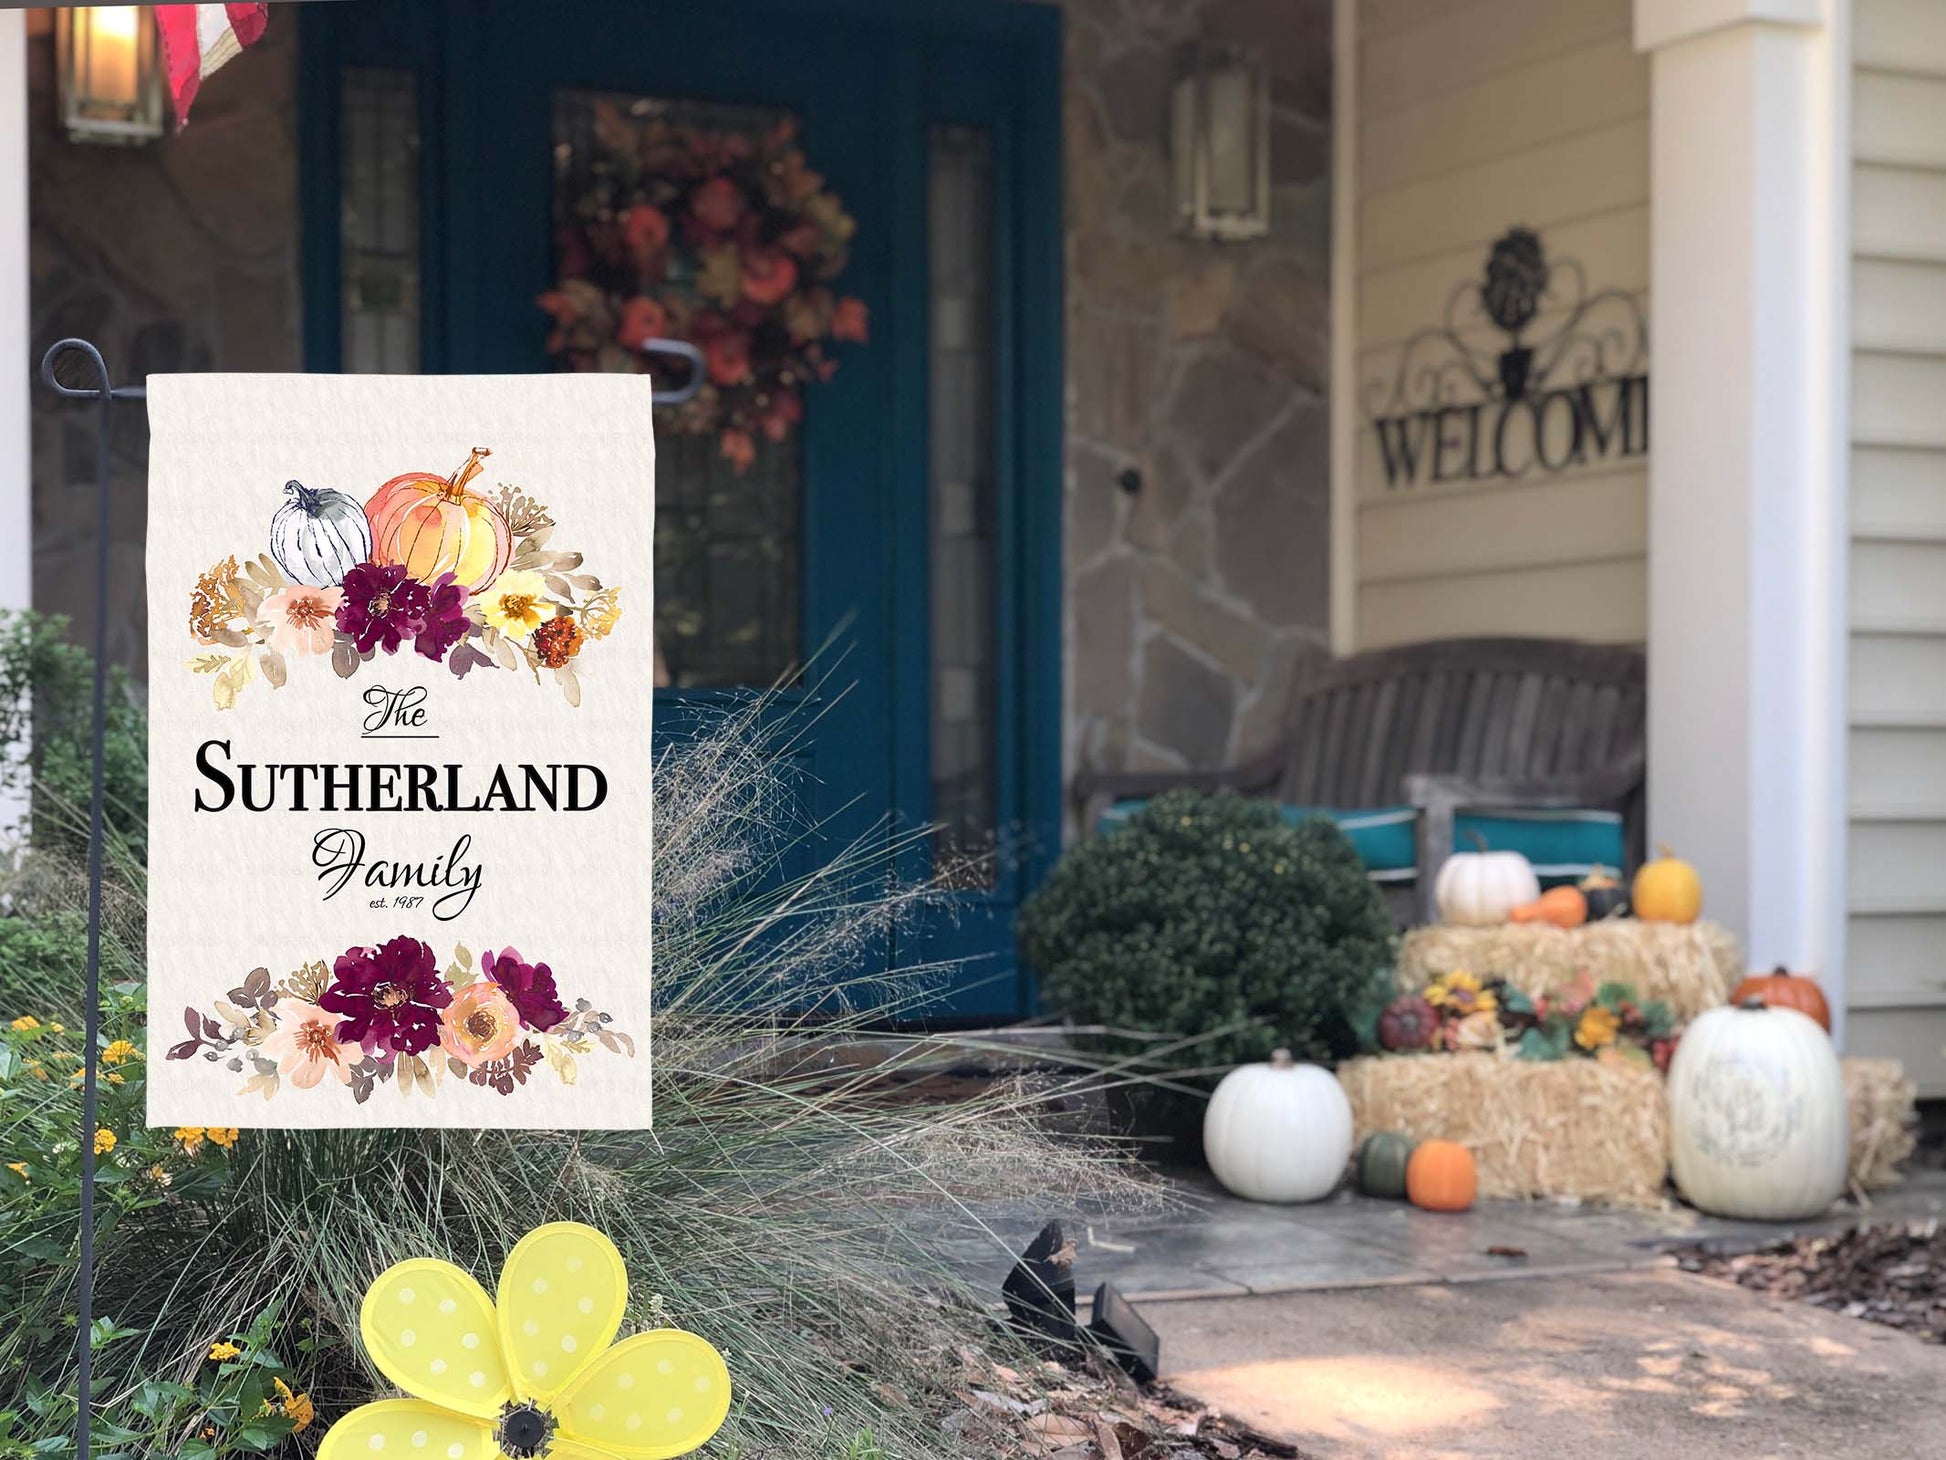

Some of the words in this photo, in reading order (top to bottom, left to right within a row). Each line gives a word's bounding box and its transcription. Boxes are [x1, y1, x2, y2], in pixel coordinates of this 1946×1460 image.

[1374, 374, 1648, 490] WELCOM
[361, 684, 428, 734] The
[194, 740, 608, 813] SUTHERLAND
[311, 827, 482, 921] Family
[369, 897, 389, 909] est.
[392, 896, 425, 909] 1987
